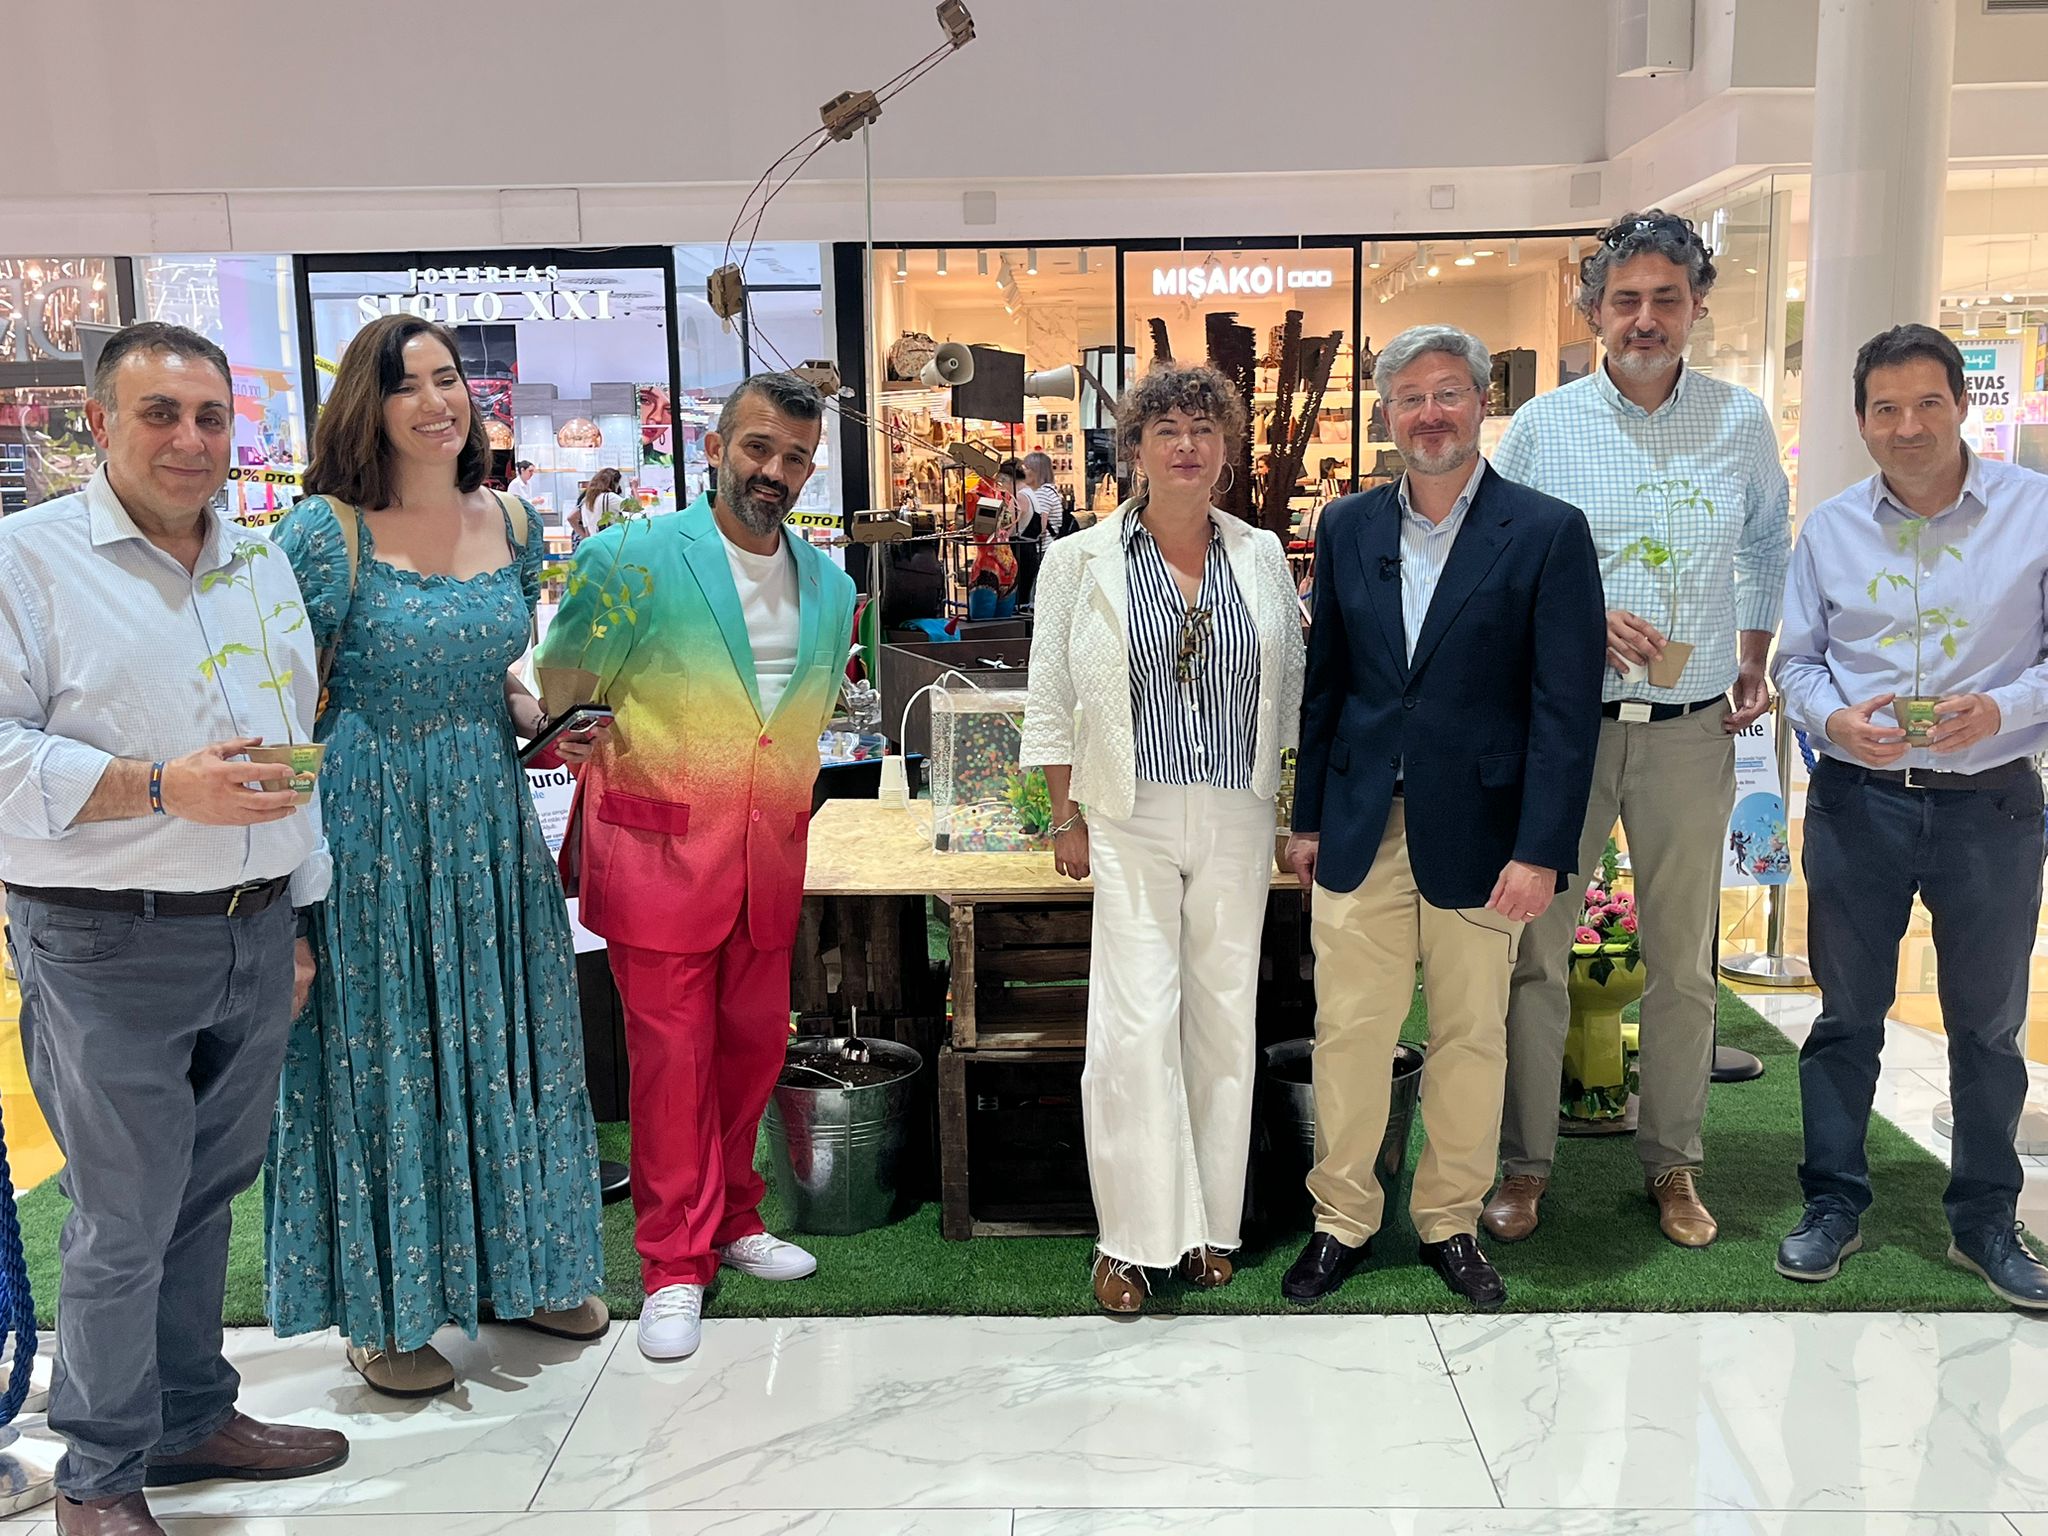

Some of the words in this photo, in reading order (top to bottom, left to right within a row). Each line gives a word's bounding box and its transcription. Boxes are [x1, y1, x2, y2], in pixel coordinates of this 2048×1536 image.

[407, 265, 560, 289] JOYERIAS
[357, 292, 503, 324] SIGLO
[523, 290, 615, 321] XXI
[264, 472, 296, 484] DTO
[1739, 723, 1764, 737] rte
